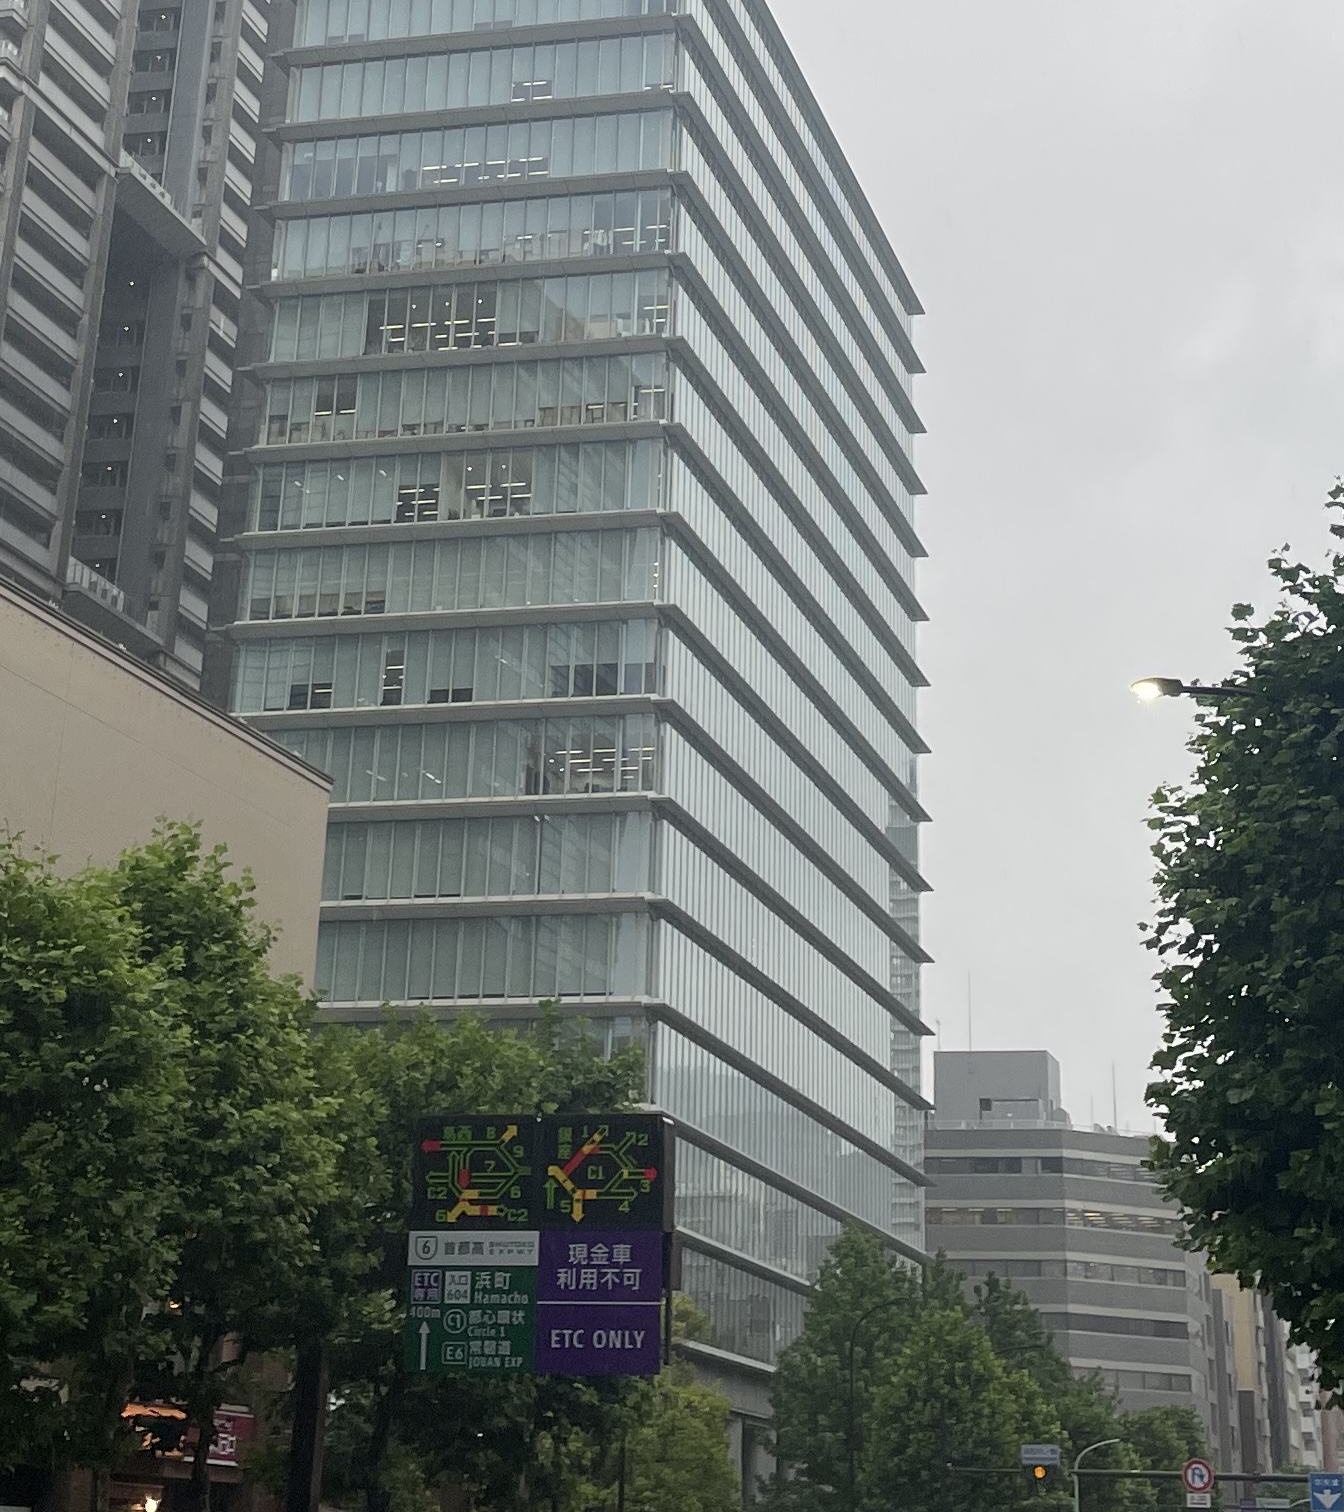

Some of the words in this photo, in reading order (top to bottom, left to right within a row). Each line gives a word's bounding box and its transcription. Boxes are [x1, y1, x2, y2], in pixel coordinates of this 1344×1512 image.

[582, 1126, 589, 1138] 1
[638, 1134, 649, 1146] 2
[484, 1161, 496, 1173] 7
[640, 1180, 651, 1193] 3
[422, 1239, 431, 1255] 6
[568, 1243, 633, 1265] 現金車
[414, 1272, 439, 1287] ETC
[447, 1274, 469, 1286] 入口
[475, 1271, 511, 1290] 浜町
[556, 1268, 642, 1290] 利用不可
[446, 1289, 468, 1301] 604
[473, 1291, 529, 1304] Hamacho
[447, 1314, 461, 1328] C1
[550, 1329, 585, 1348] ETC
[592, 1329, 646, 1348] ONLY
[446, 1346, 464, 1360] E6
